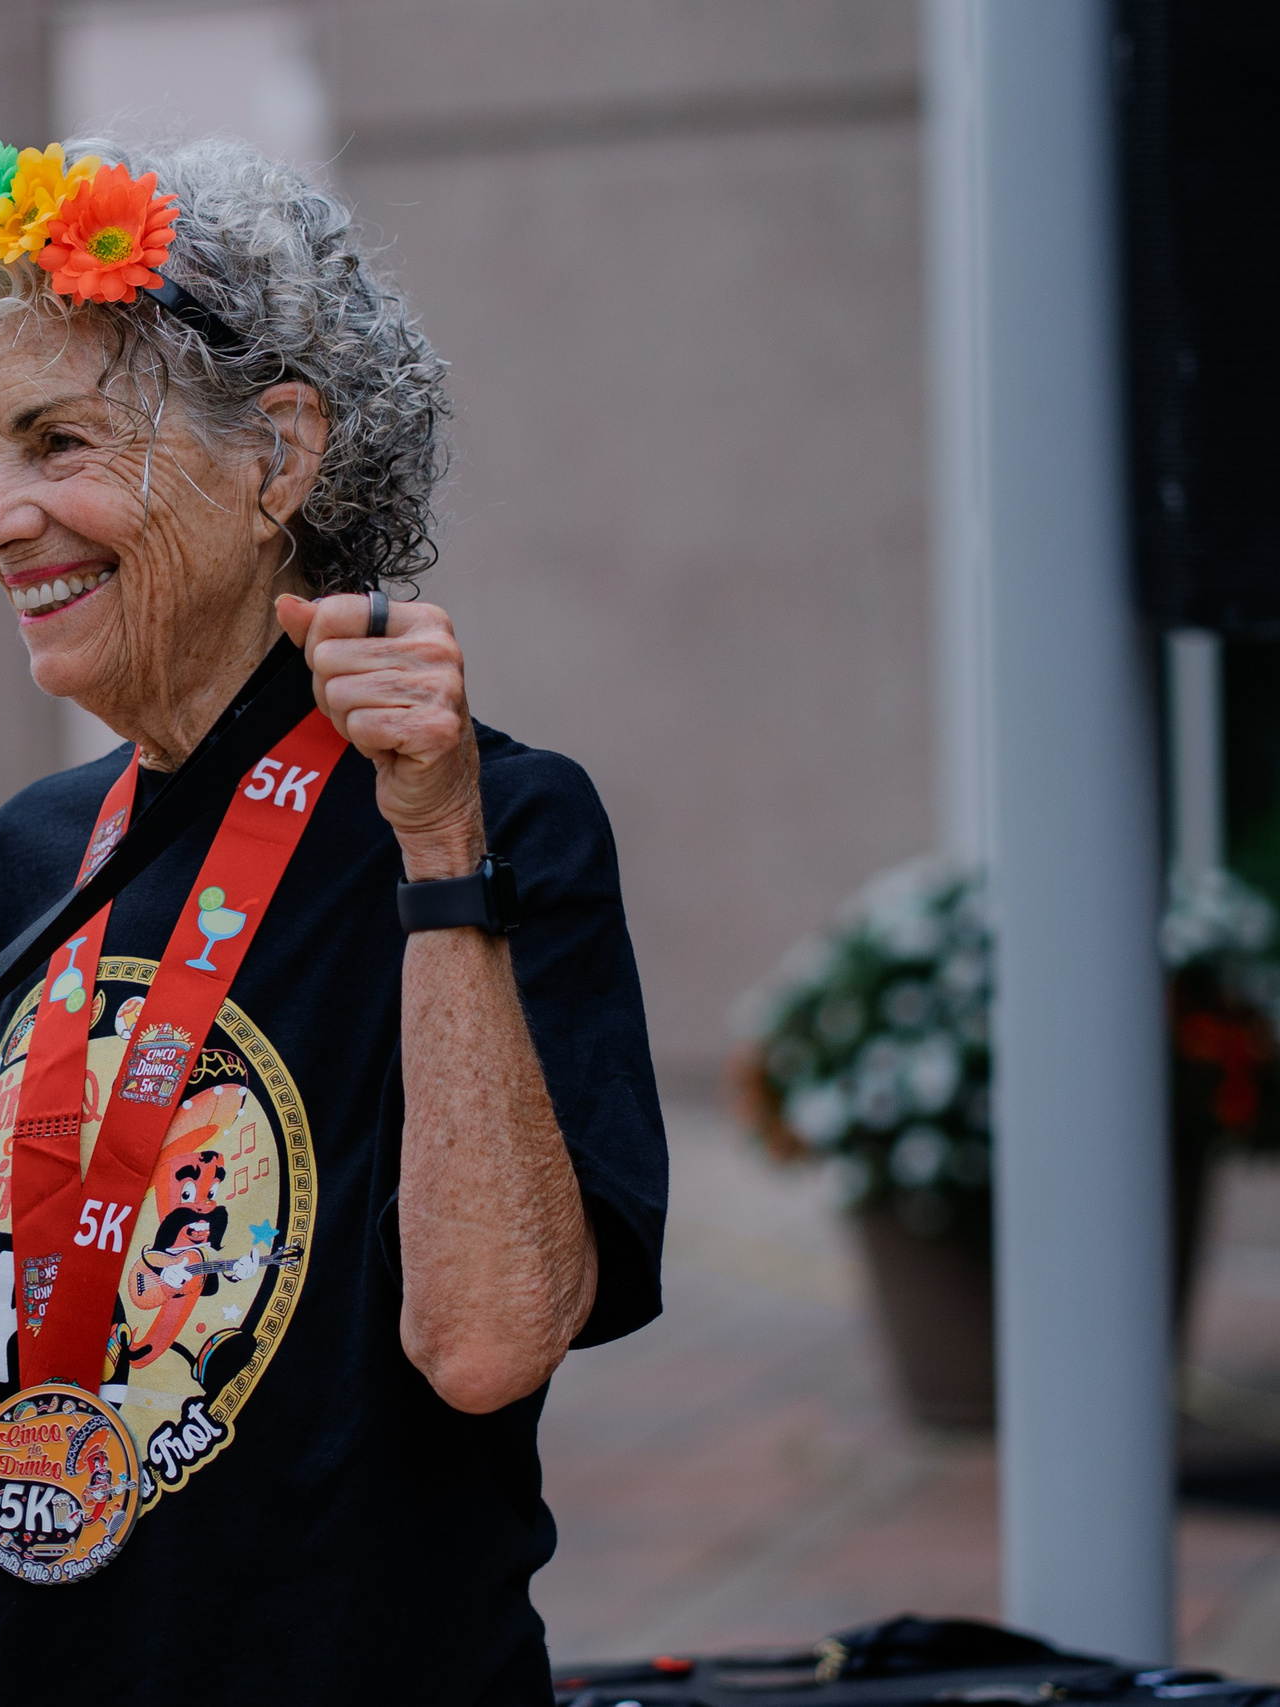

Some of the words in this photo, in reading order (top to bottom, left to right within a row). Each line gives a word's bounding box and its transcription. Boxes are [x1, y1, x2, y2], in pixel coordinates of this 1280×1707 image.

[244, 757, 320, 812] 5K
[136, 1059, 173, 1076] DRINKO
[146, 1049, 176, 1060] CINCO
[140, 1079, 154, 1092] 5K
[74, 1199, 132, 1253] 5K
[28, 1444, 42, 1455] de
[150, 1402, 222, 1479] Trot
[0, 1484, 56, 1533] 5K
[22, 1562, 50, 1581] Mile
[52, 1565, 62, 1580] &
[64, 1558, 93, 1579] Taco
[89, 1535, 117, 1564] Trot
